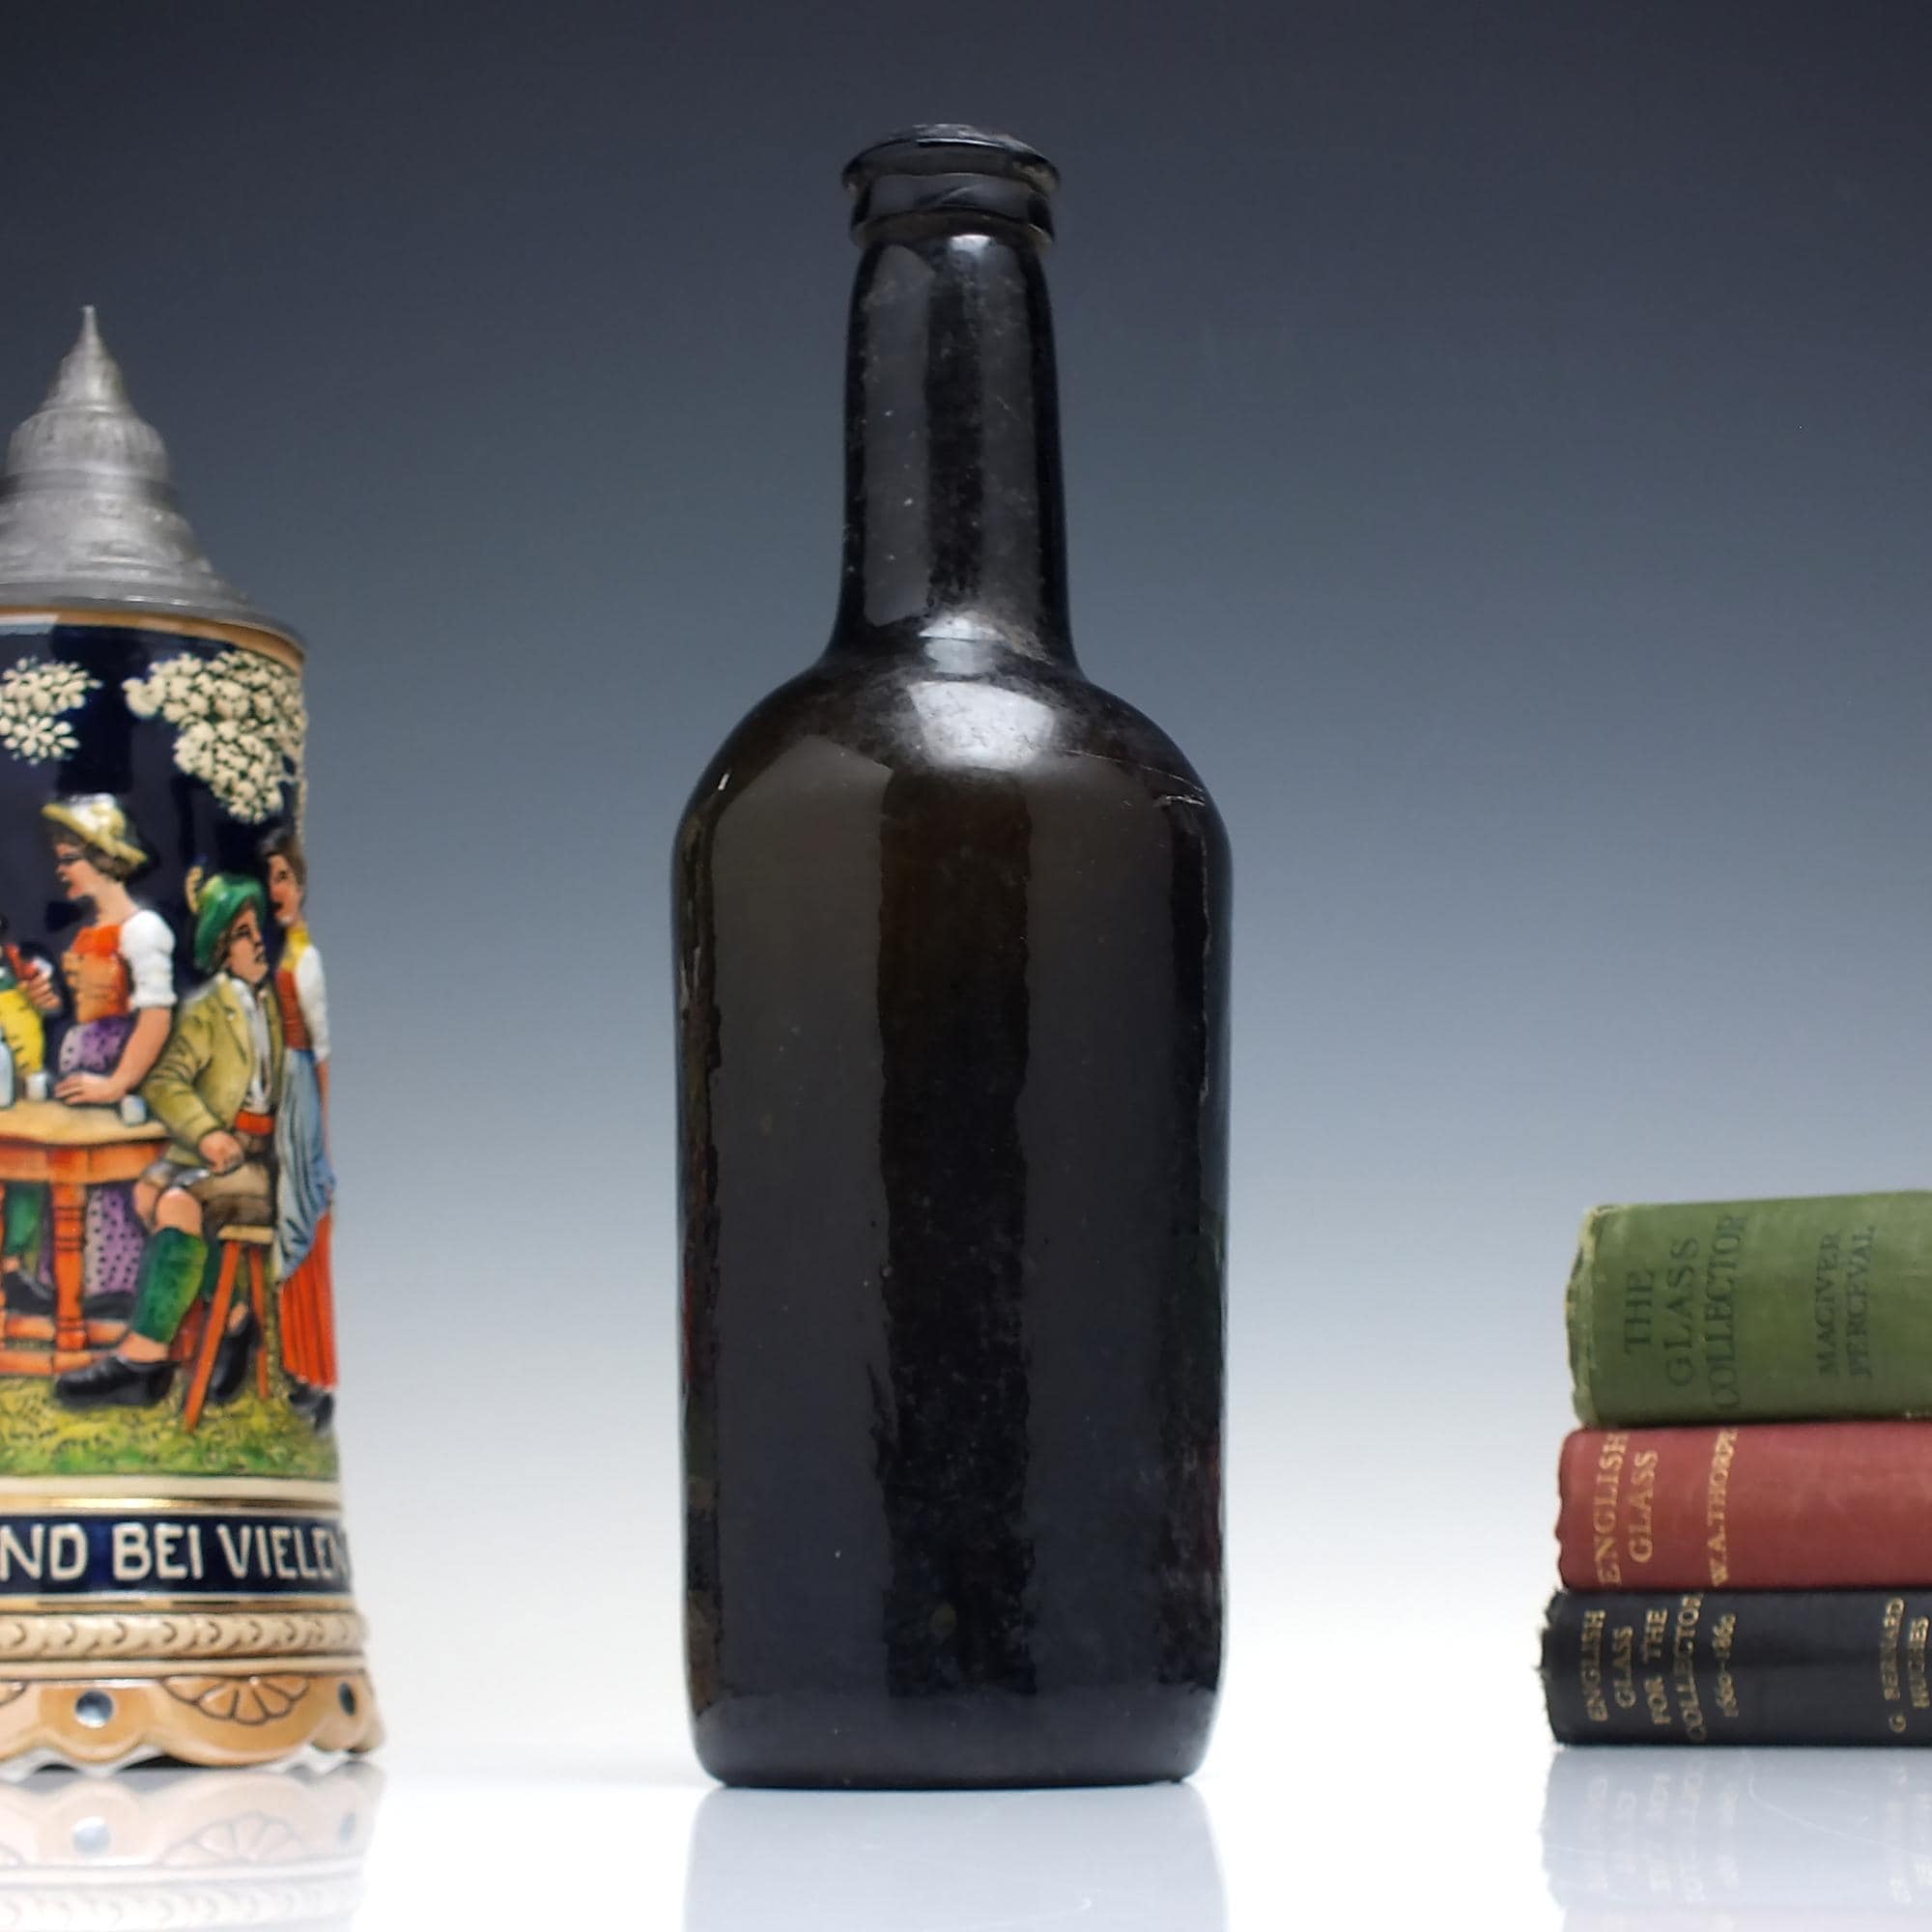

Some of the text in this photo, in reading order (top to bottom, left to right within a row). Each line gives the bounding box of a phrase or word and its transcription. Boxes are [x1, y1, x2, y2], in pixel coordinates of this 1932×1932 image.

[1625, 1269, 1655, 1354] THE
[1663, 1236, 1699, 1386] GLASS
[1704, 1213, 1748, 1408] COLLECTOR
[1814, 1233, 1840, 1376] MACIVER
[112, 1520, 203, 1580] BEI
[1593, 1433, 1630, 1585] ENGLISH
[1629, 1450, 1659, 1563] GLASS
[1580, 1609, 1608, 1721] ENGLISH
[1612, 1626, 1636, 1709] GLASS
[1642, 1608, 1671, 1725] FOR THE
